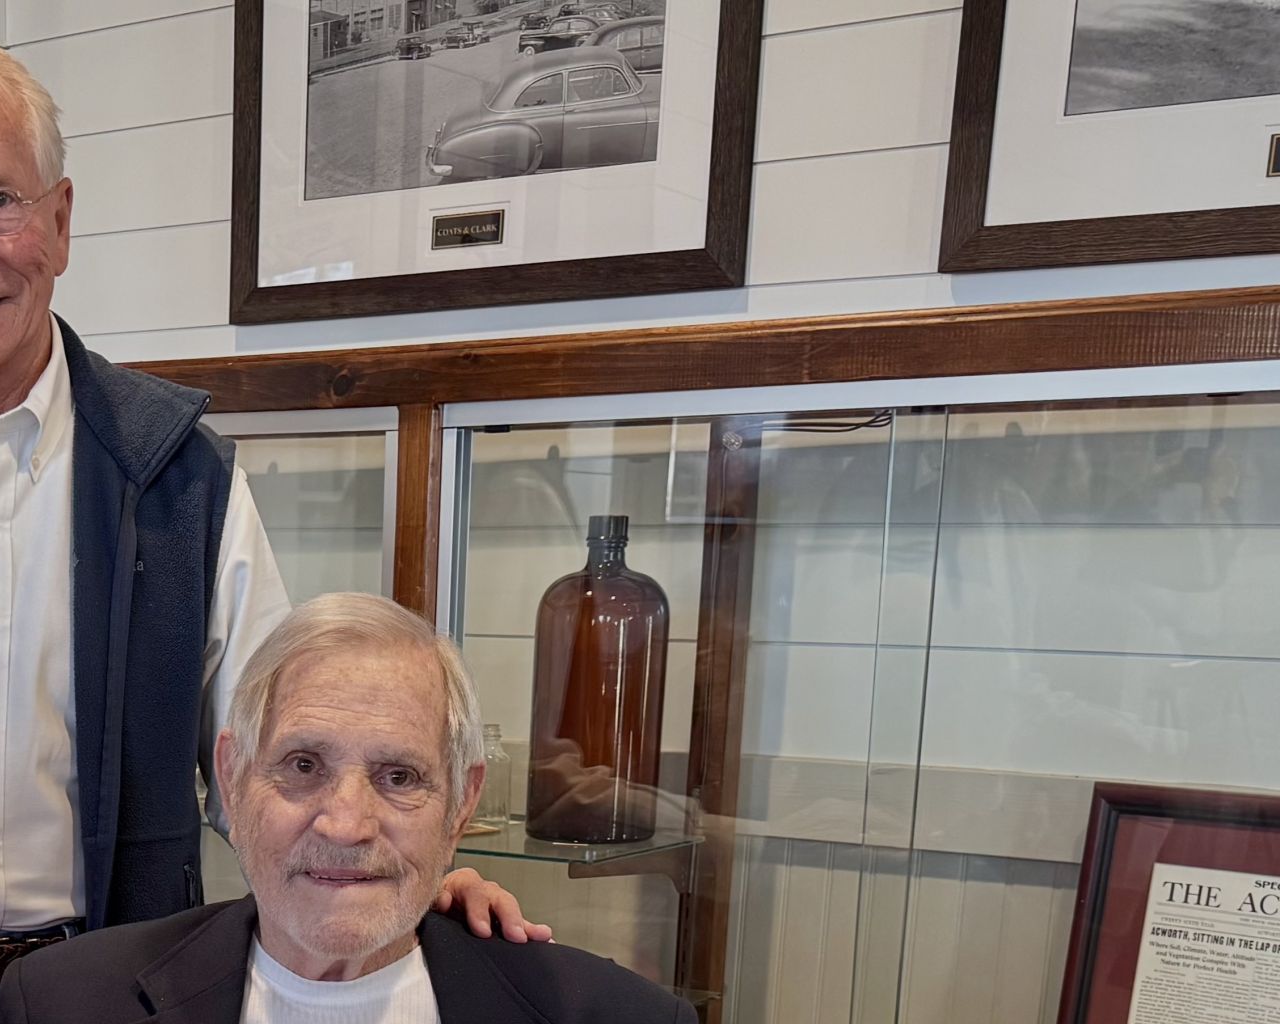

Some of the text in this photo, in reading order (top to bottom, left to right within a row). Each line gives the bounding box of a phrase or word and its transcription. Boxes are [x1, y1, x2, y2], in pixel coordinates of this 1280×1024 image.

[437, 227, 462, 237] COATS
[470, 223, 498, 233] CLARK
[1162, 881, 1280, 916] THE AC
[1151, 927, 1190, 942] ACWORTH,
[1192, 932, 1225, 948] SITTING
[1226, 937, 1236, 947] IN
[1238, 938, 1254, 950] THE
[1255, 941, 1270, 953] LAP
